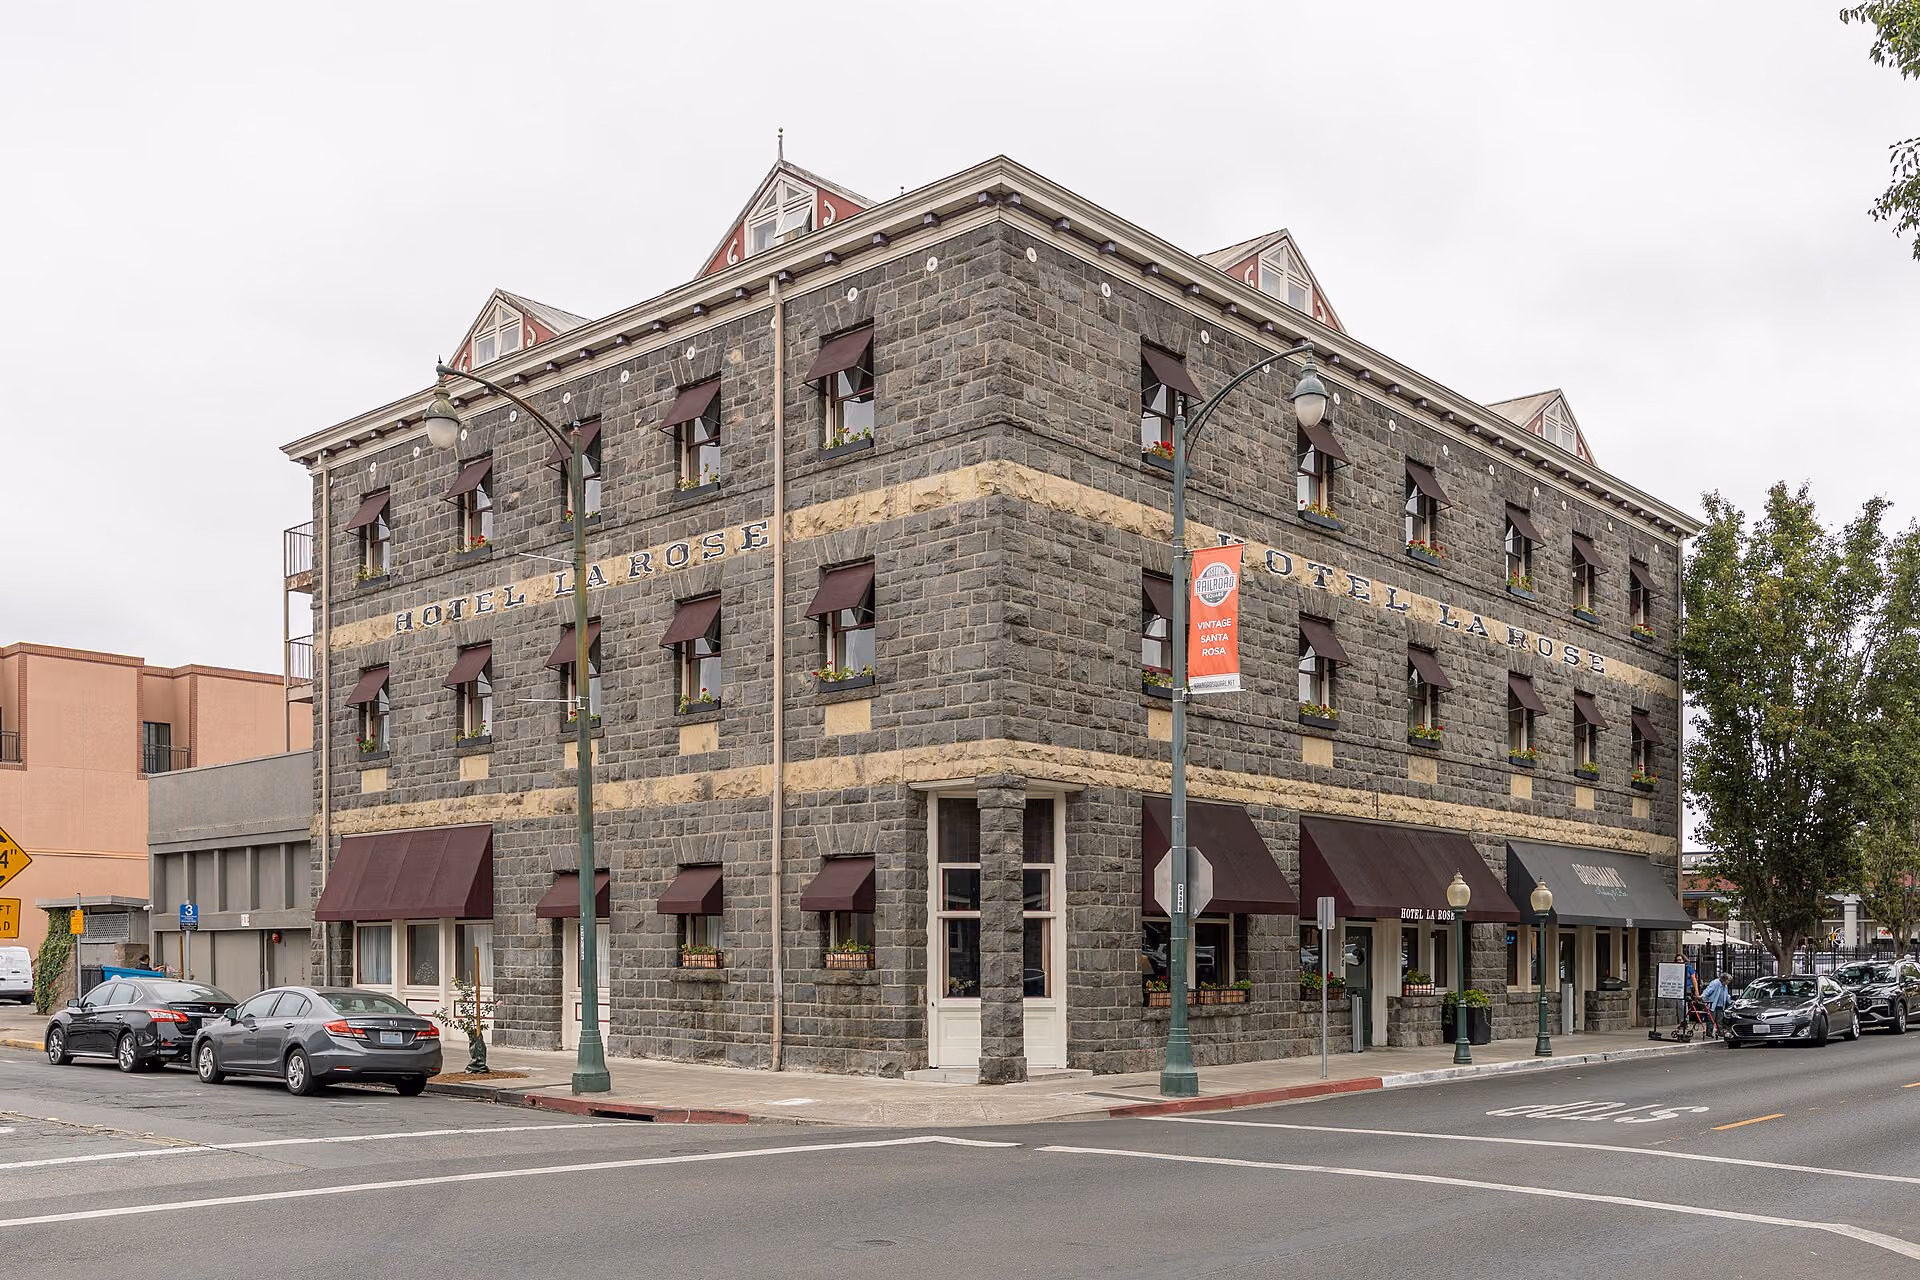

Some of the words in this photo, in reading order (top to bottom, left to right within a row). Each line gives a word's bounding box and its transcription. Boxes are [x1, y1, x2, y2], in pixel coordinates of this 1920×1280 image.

[394, 585, 525, 634] HOTEL
[555, 564, 608, 595] LA
[629, 520, 769, 579] ROSE
[1196, 576, 1234, 592] RAILROAD
[1197, 618, 1232, 629] VINTAGE
[1200, 633, 1229, 643] SANTA
[1439, 604, 1489, 638] LA
[1506, 625, 1605, 674] ROSE
[1202, 647, 1226, 657] ROSA
[184, 904, 193, 916] 3
[1400, 907, 1424, 919] HOTEL
[1426, 909, 1435, 920] LA
[1437, 909, 1456, 921] ROSE
